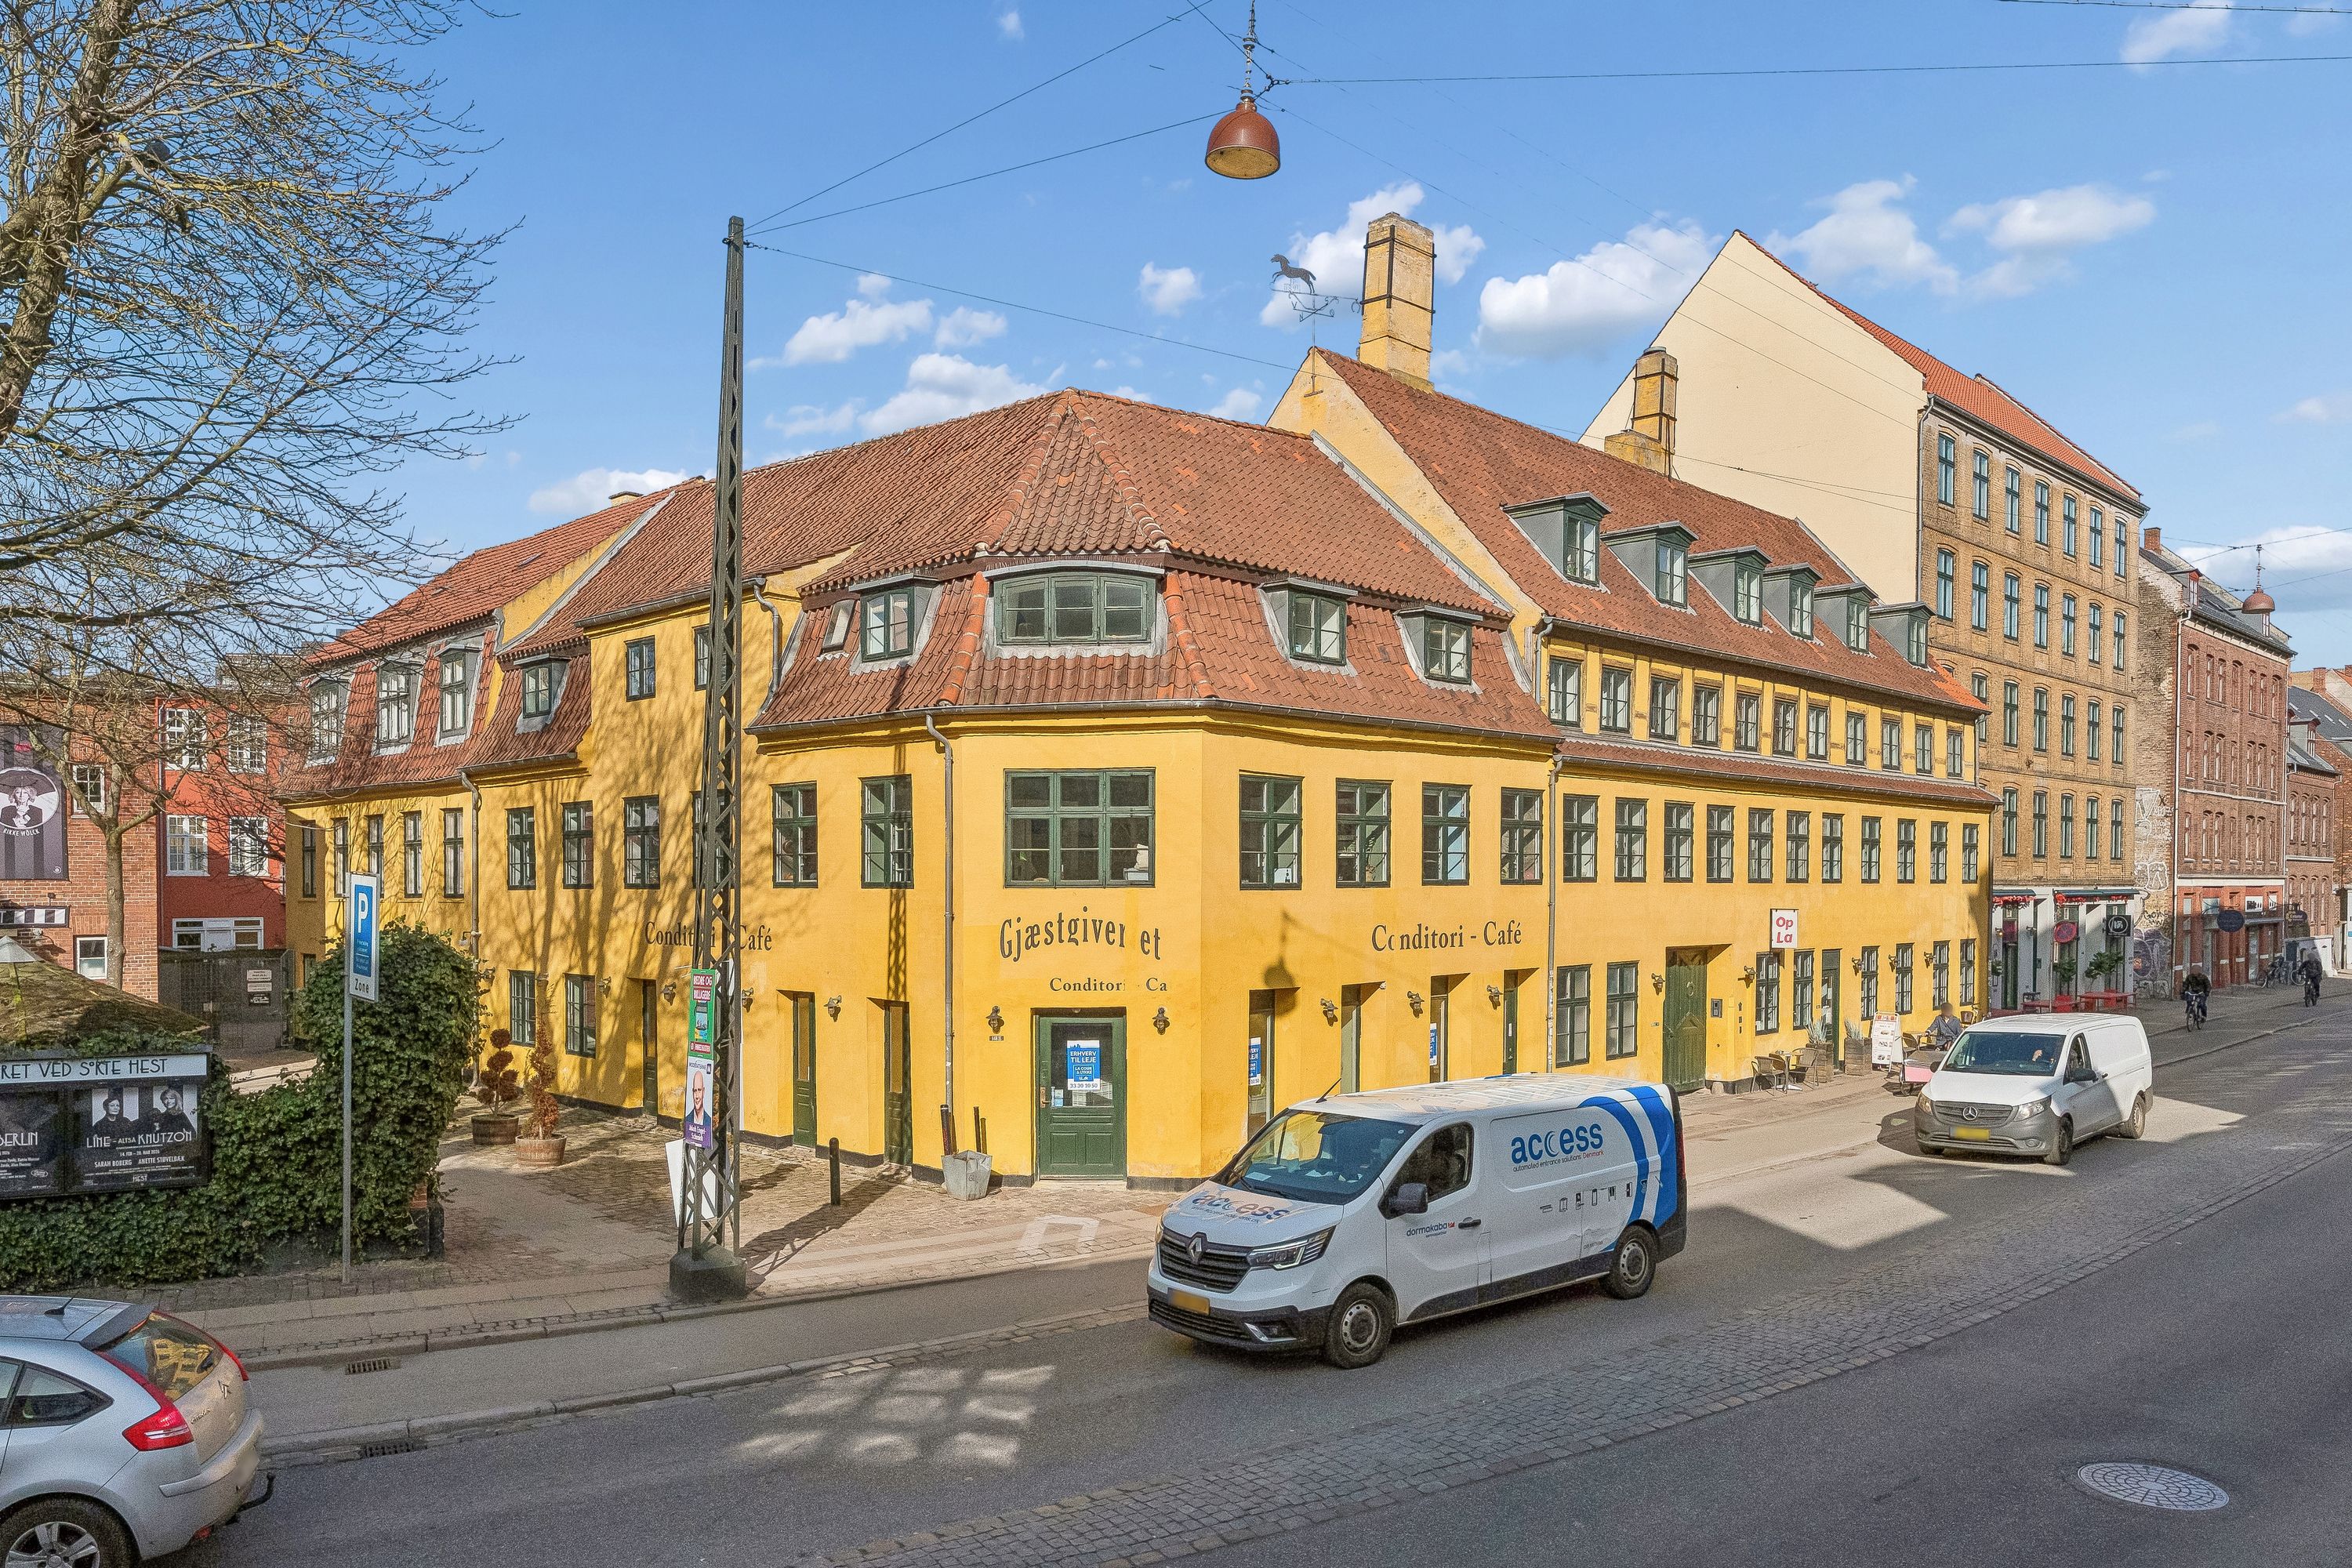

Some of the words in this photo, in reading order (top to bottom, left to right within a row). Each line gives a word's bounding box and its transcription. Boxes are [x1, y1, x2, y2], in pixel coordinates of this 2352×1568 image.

[3, 828, 20, 837] RIKKE
[358, 892, 369, 933] P
[1776, 916, 1794, 930] Op
[644, 921, 717, 948] Conditi
[1483, 920, 1522, 946] Café
[1776, 931, 1793, 943] La
[354, 978, 369, 993] Zone
[706, 976, 713, 986] OG
[2, 1064, 31, 1079] RET
[38, 1062, 71, 1077] VED
[129, 1058, 168, 1074] HEST
[86, 1134, 111, 1149] LINE
[138, 1131, 192, 1145] KNUTZON
[1511, 1123, 1603, 1164] access
[1513, 1162, 1539, 1172] automated
[1540, 1157, 1561, 1167] entrance
[1562, 1153, 1582, 1163] solutions
[1583, 1149, 1604, 1160] Denmark
[1192, 1195, 1290, 1220] access
[1406, 1222, 1447, 1236] dormakaba
